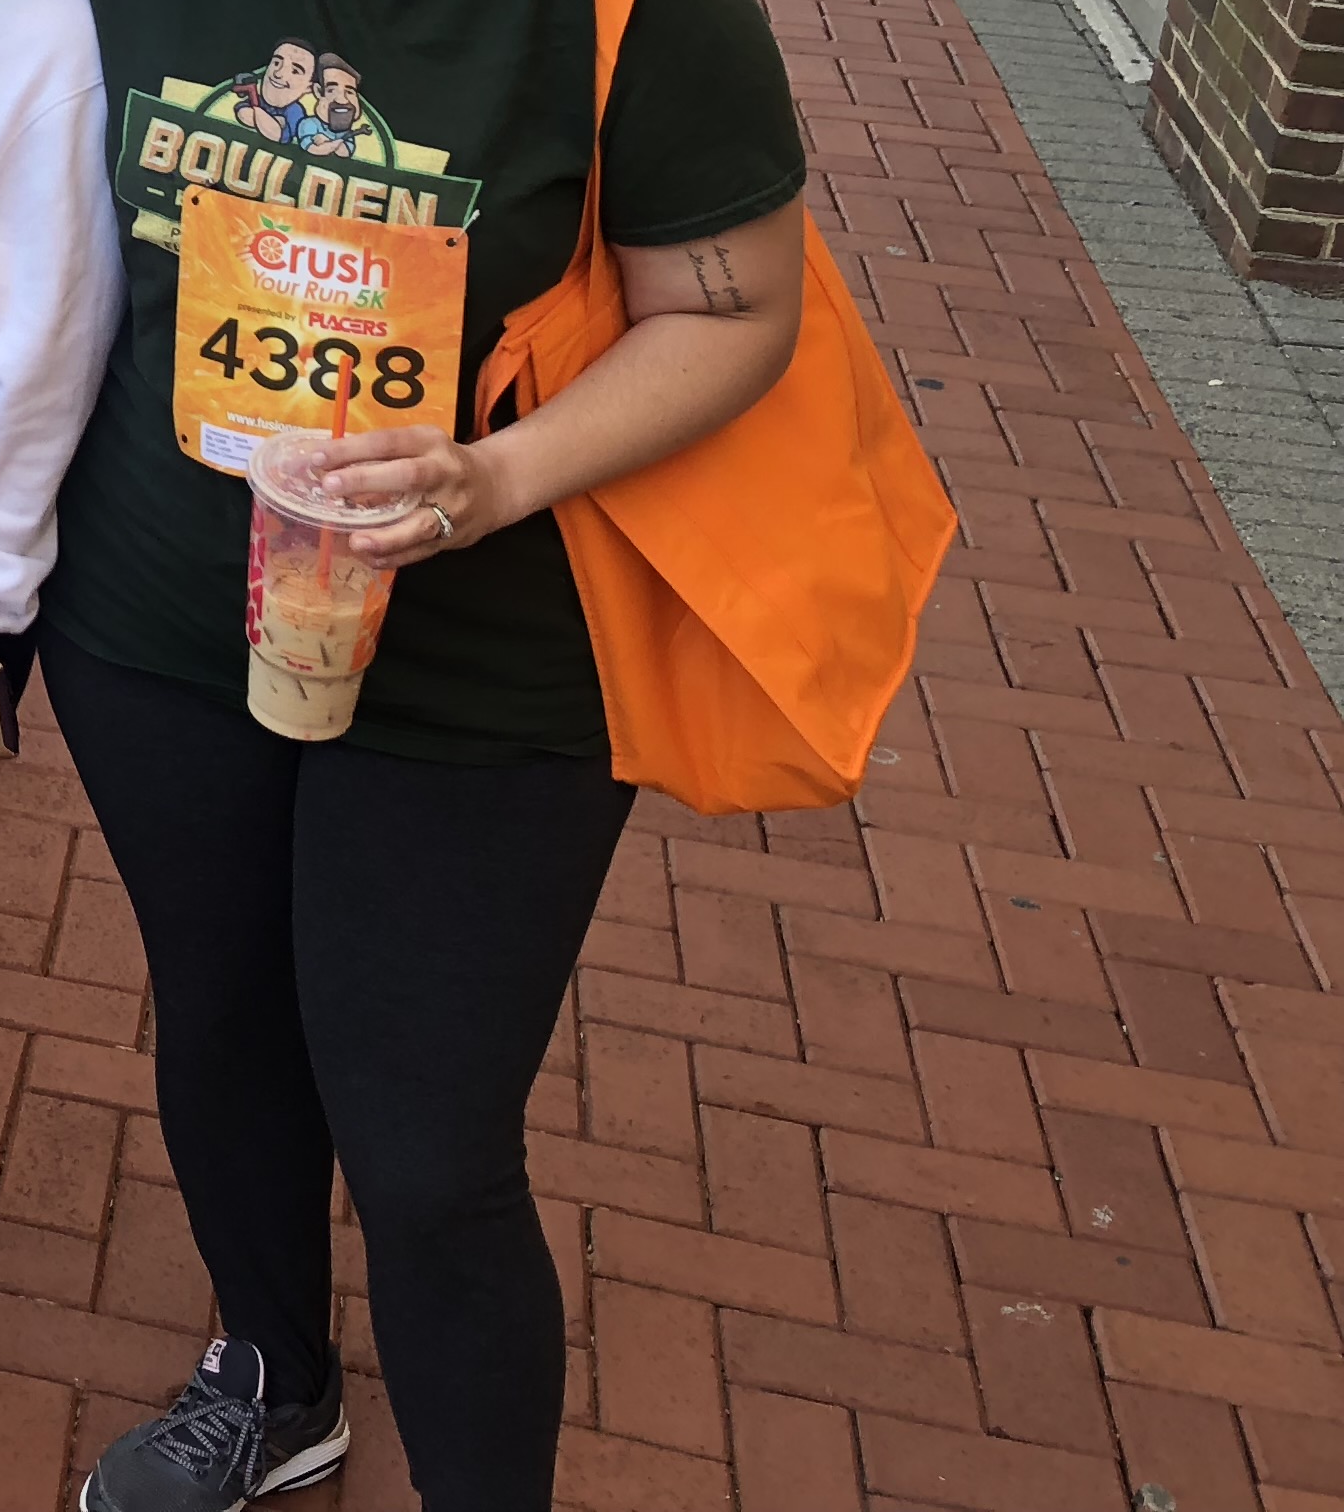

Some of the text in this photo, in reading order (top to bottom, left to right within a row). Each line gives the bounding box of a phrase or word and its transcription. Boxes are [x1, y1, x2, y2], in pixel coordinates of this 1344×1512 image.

[139, 117, 439, 228] BOULDEN
[249, 230, 391, 289] Crush
[237, 303, 284, 319] presented
[285, 310, 297, 322] by
[252, 270, 389, 310] Your Run 5K
[200, 317, 426, 409] 4388
